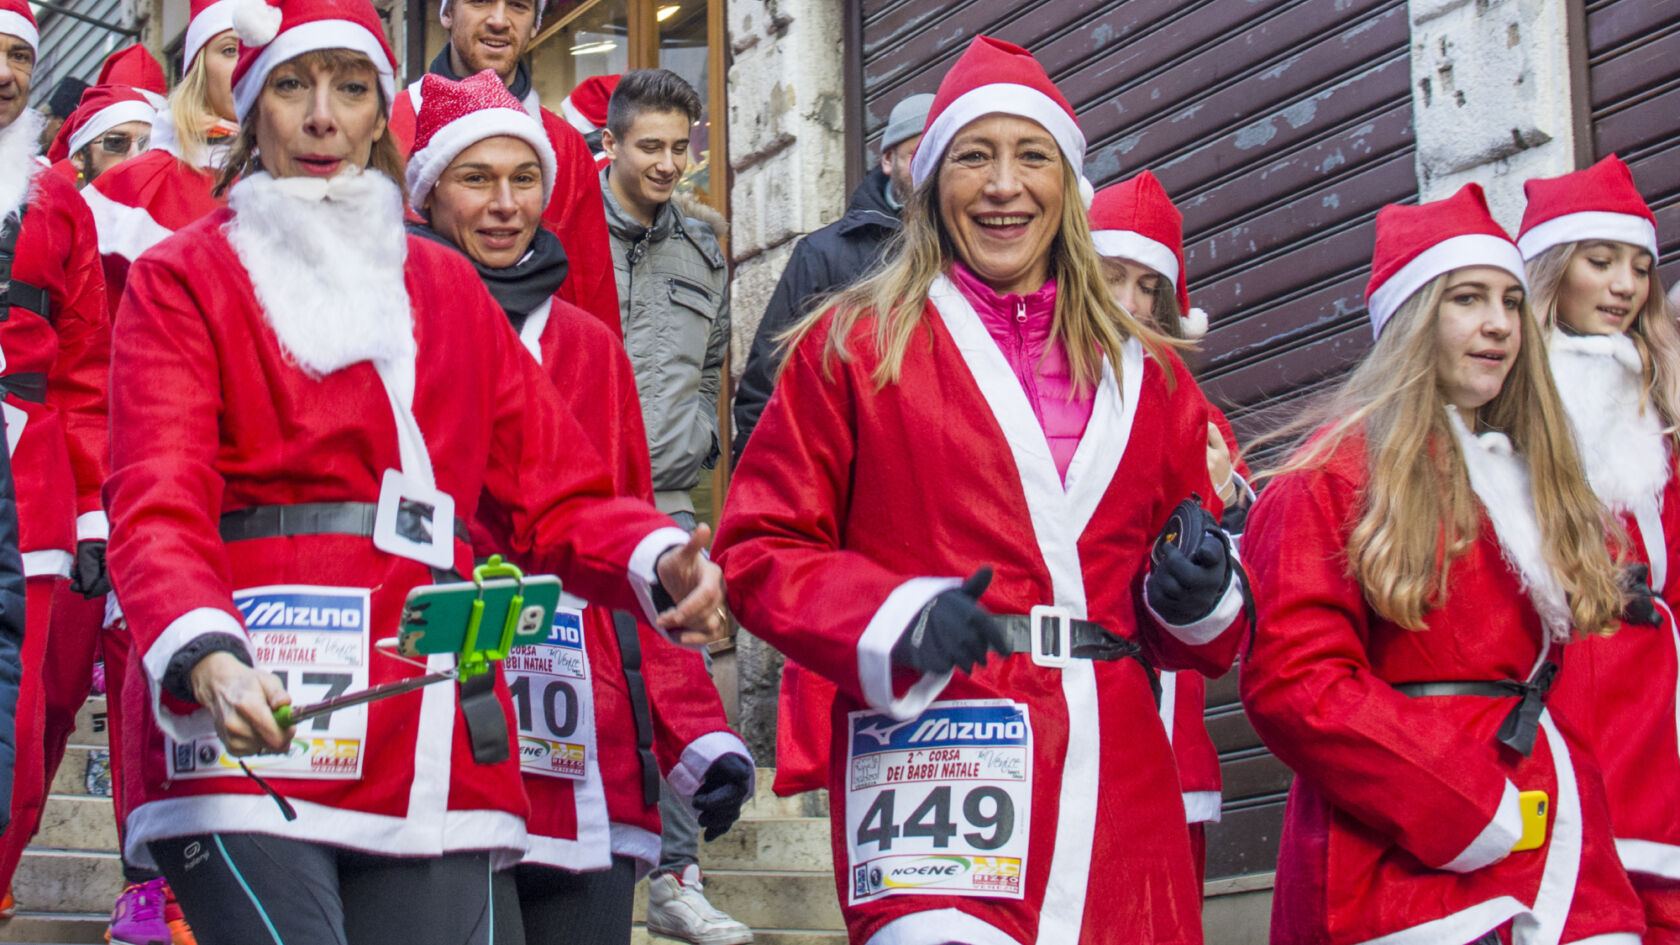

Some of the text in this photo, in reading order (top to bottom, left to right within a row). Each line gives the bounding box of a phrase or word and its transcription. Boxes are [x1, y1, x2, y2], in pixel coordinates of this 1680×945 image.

[245, 601, 360, 627] MIZUNO
[264, 633, 297, 645] CORSA
[548, 625, 579, 643] UNO
[256, 648, 317, 662] BBI NATALE
[510, 646, 537, 656] CORSA
[505, 656, 552, 672] BBI NATALE
[908, 718, 1025, 743] MIZUNO
[929, 749, 960, 761] CORSA
[887, 762, 980, 781] DEI BABBI NATALE
[857, 786, 1015, 851] 449
[891, 865, 959, 876] NOENE
